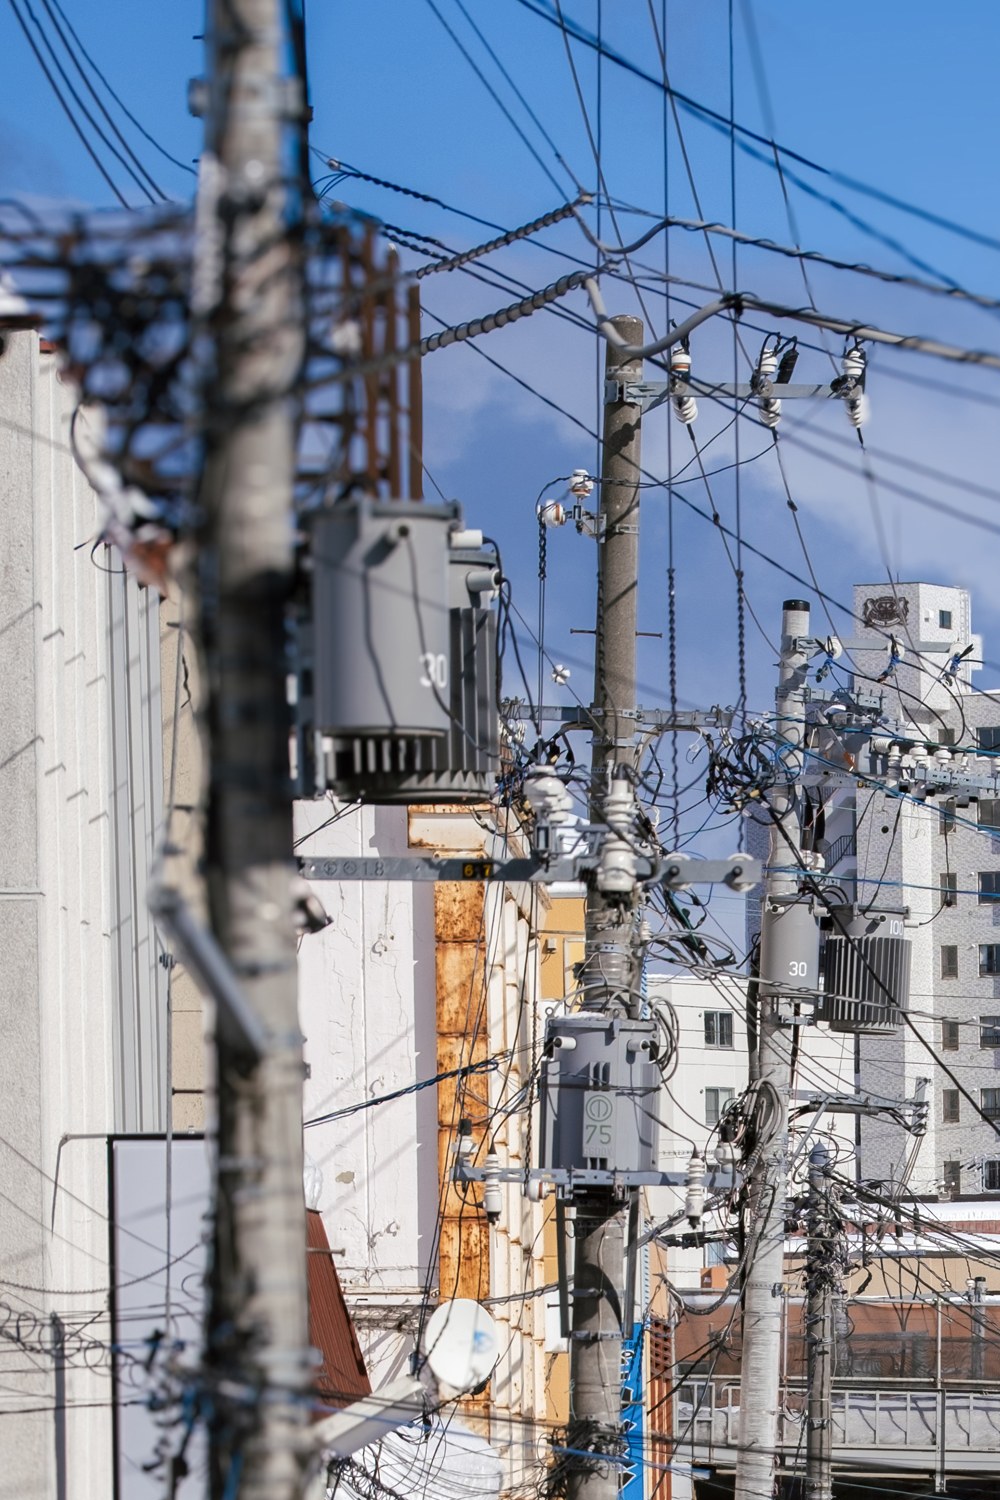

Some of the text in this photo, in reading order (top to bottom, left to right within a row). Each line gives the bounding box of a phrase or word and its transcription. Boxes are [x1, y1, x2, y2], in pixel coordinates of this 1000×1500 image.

[419, 652, 449, 689] 30
[889, 920, 905, 935] 100
[788, 961, 808, 977] 30
[585, 1124, 612, 1145] 75
